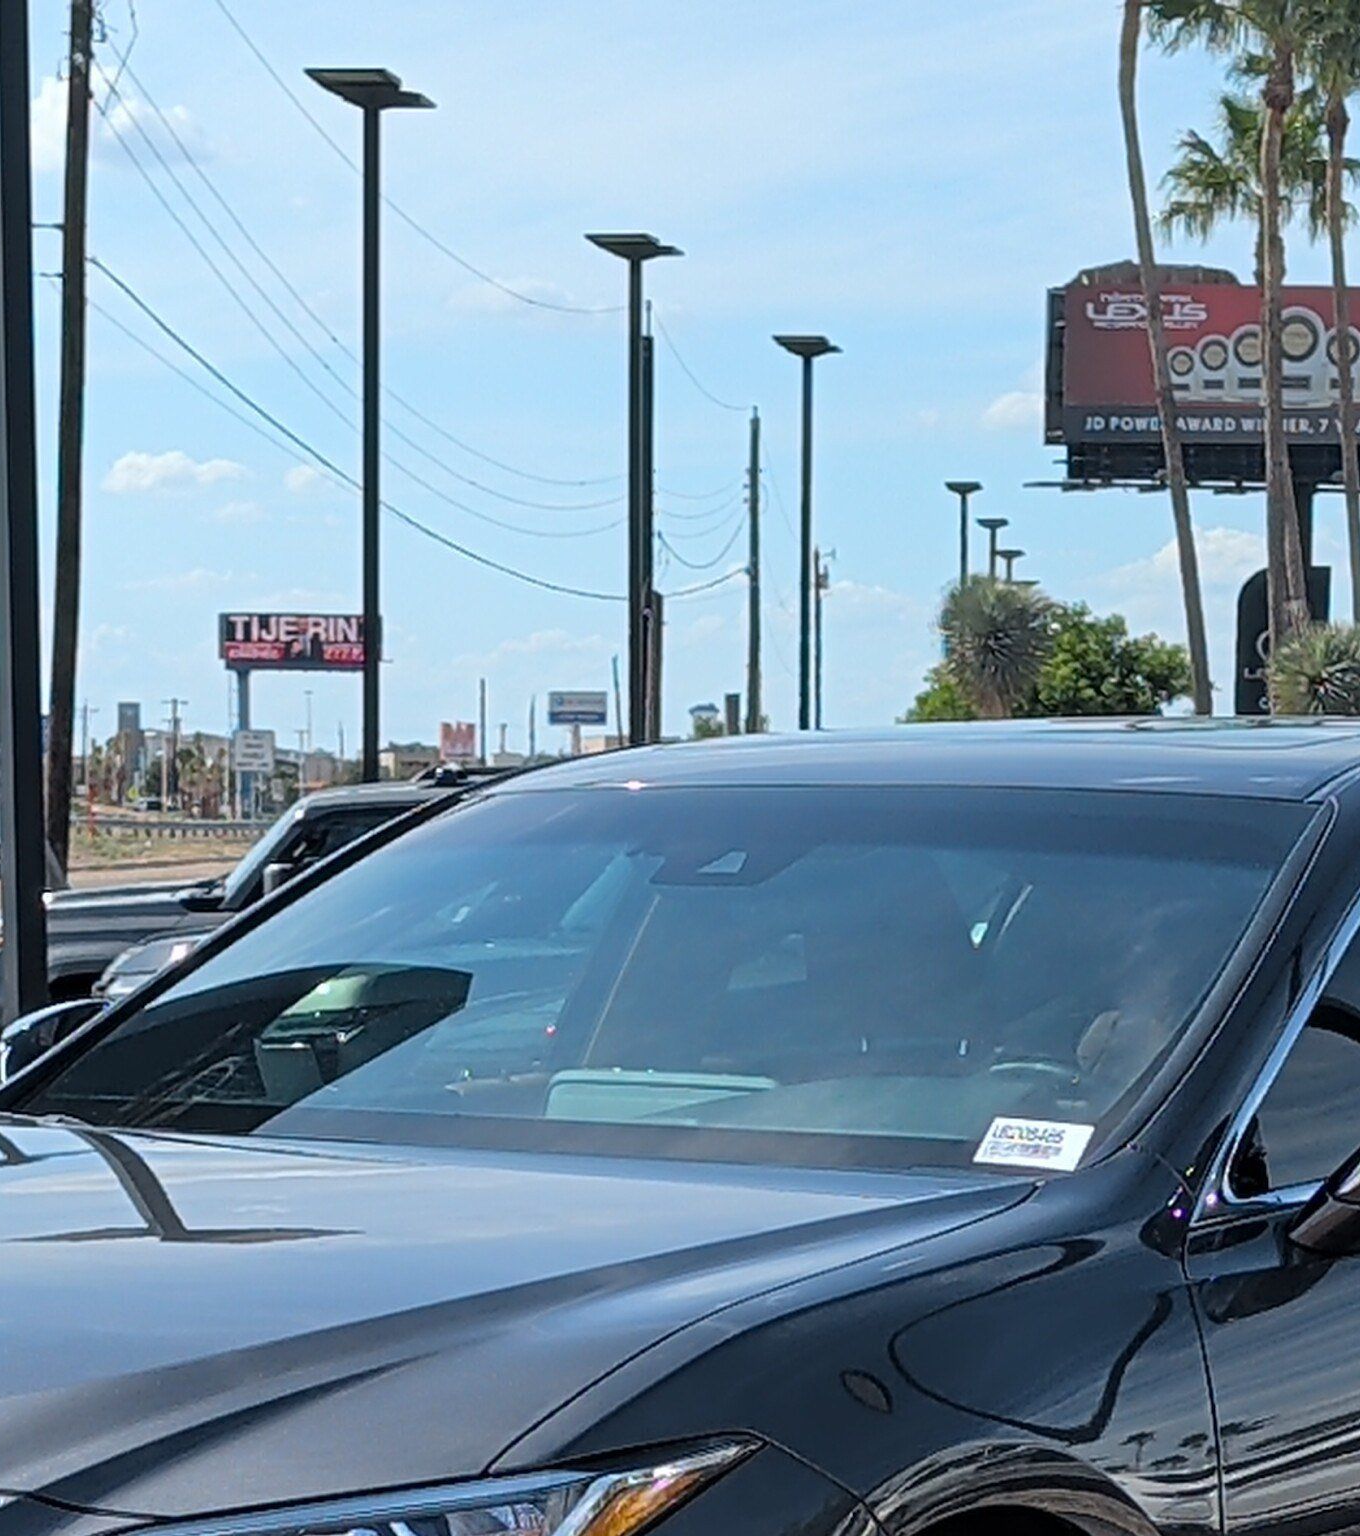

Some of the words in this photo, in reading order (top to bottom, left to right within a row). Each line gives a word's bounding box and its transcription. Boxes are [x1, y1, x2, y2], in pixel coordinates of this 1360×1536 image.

[1085, 416, 1105, 432] JD
[1110, 416, 1165, 432] POWE
[1176, 416, 1236, 432] AWARD
[1241, 416, 1314, 434] WIER,
[1318, 418, 1330, 433] 7
[228, 615, 364, 642] TIJERIN
